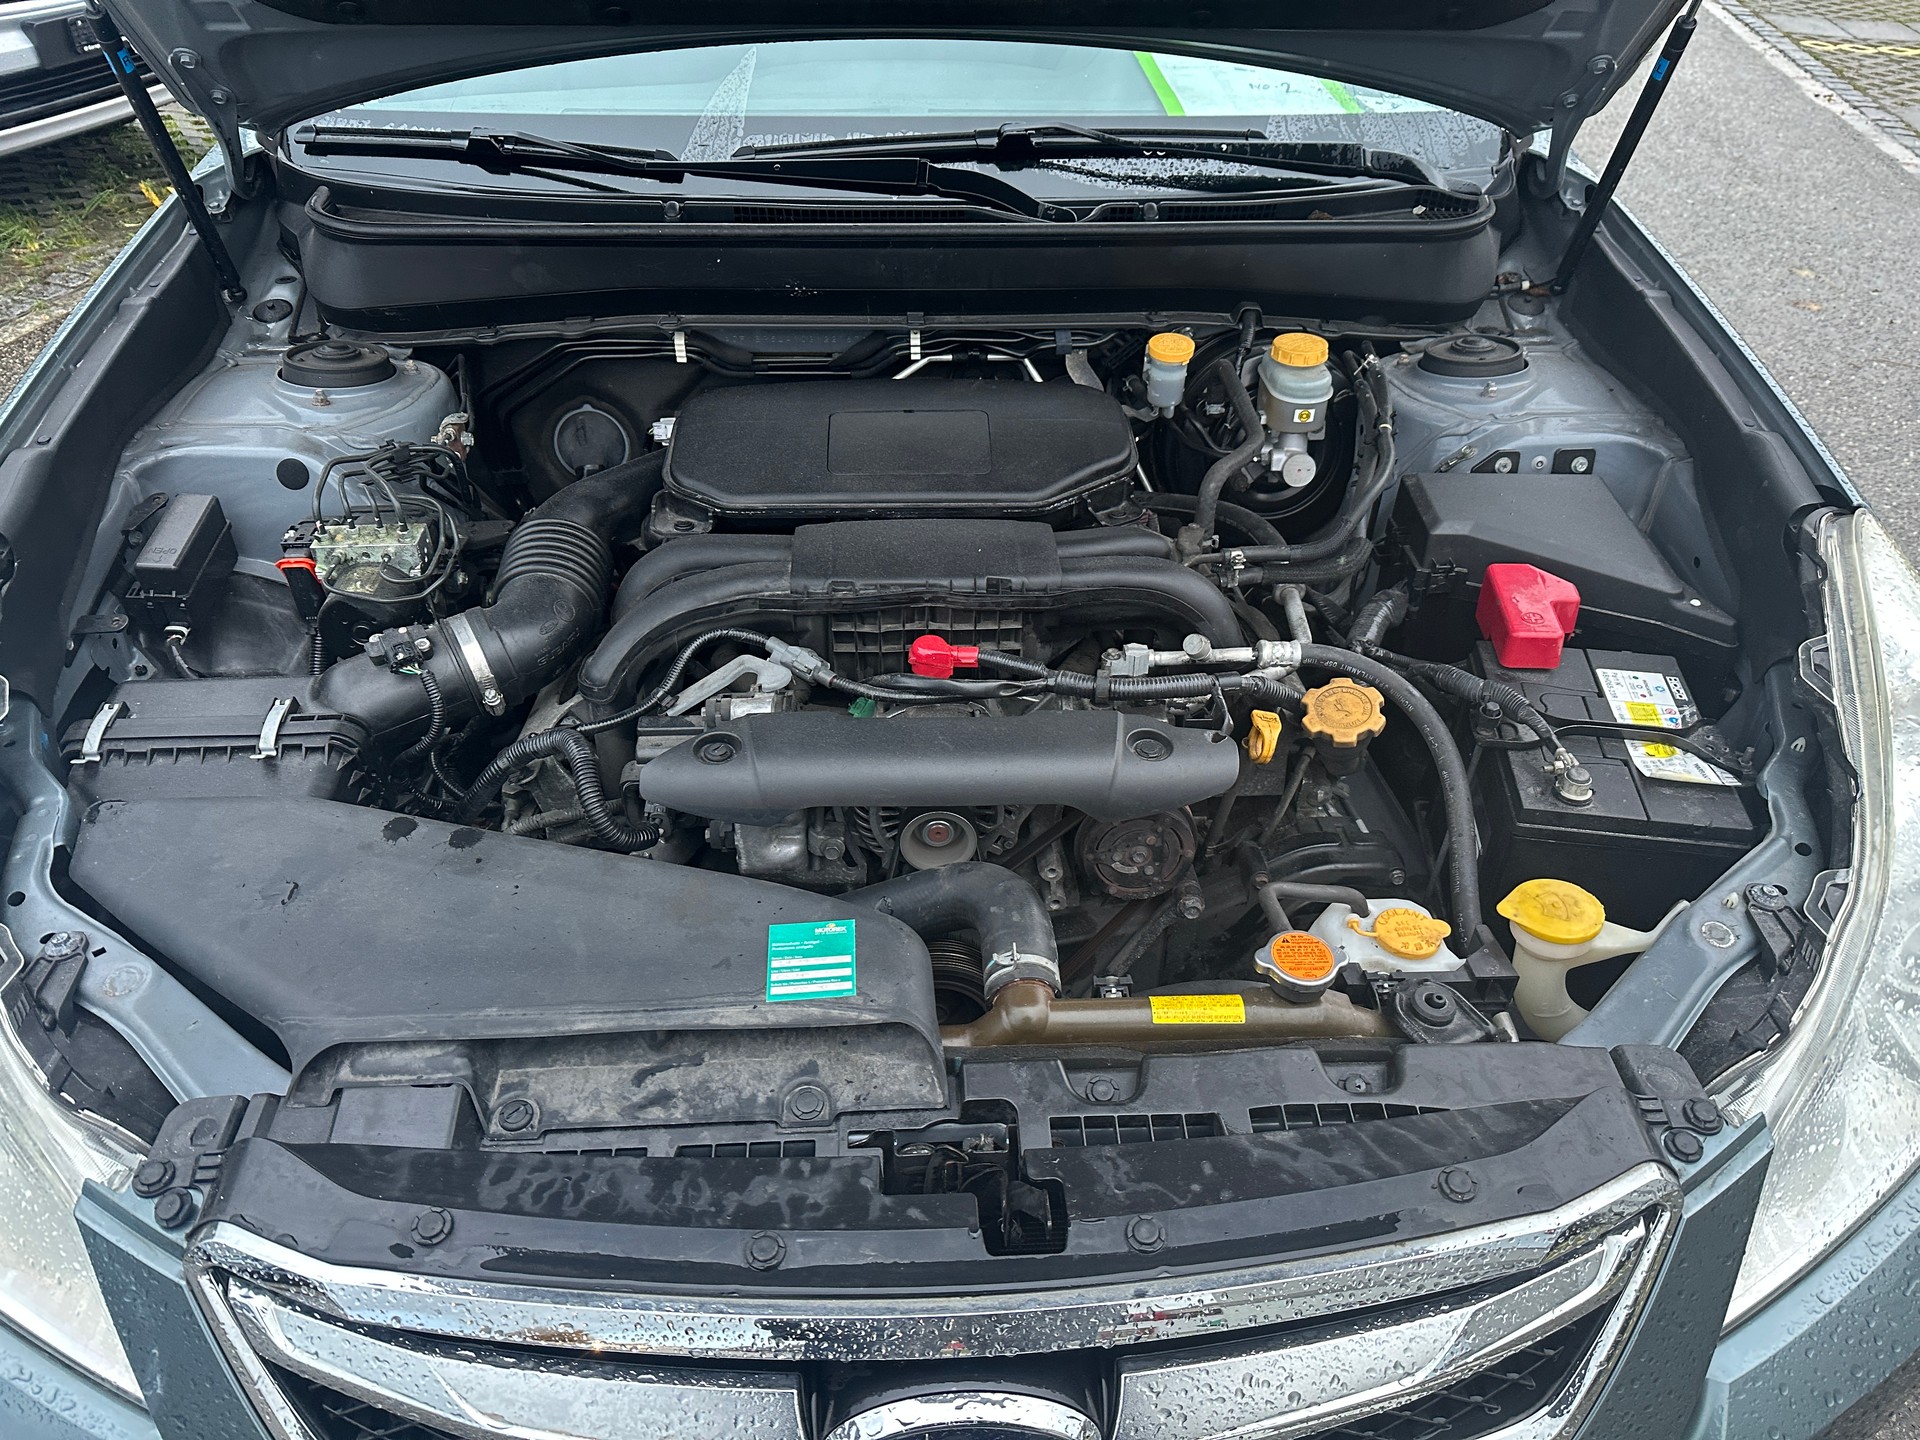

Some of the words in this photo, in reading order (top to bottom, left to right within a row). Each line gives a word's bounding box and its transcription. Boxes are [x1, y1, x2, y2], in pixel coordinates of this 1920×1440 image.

[152, 547, 178, 555] OPEN
[1389, 686, 1415, 713] NICHIRIN
[1378, 908, 1428, 926] COOLANT
[814, 925, 848, 933] MOTOREX
